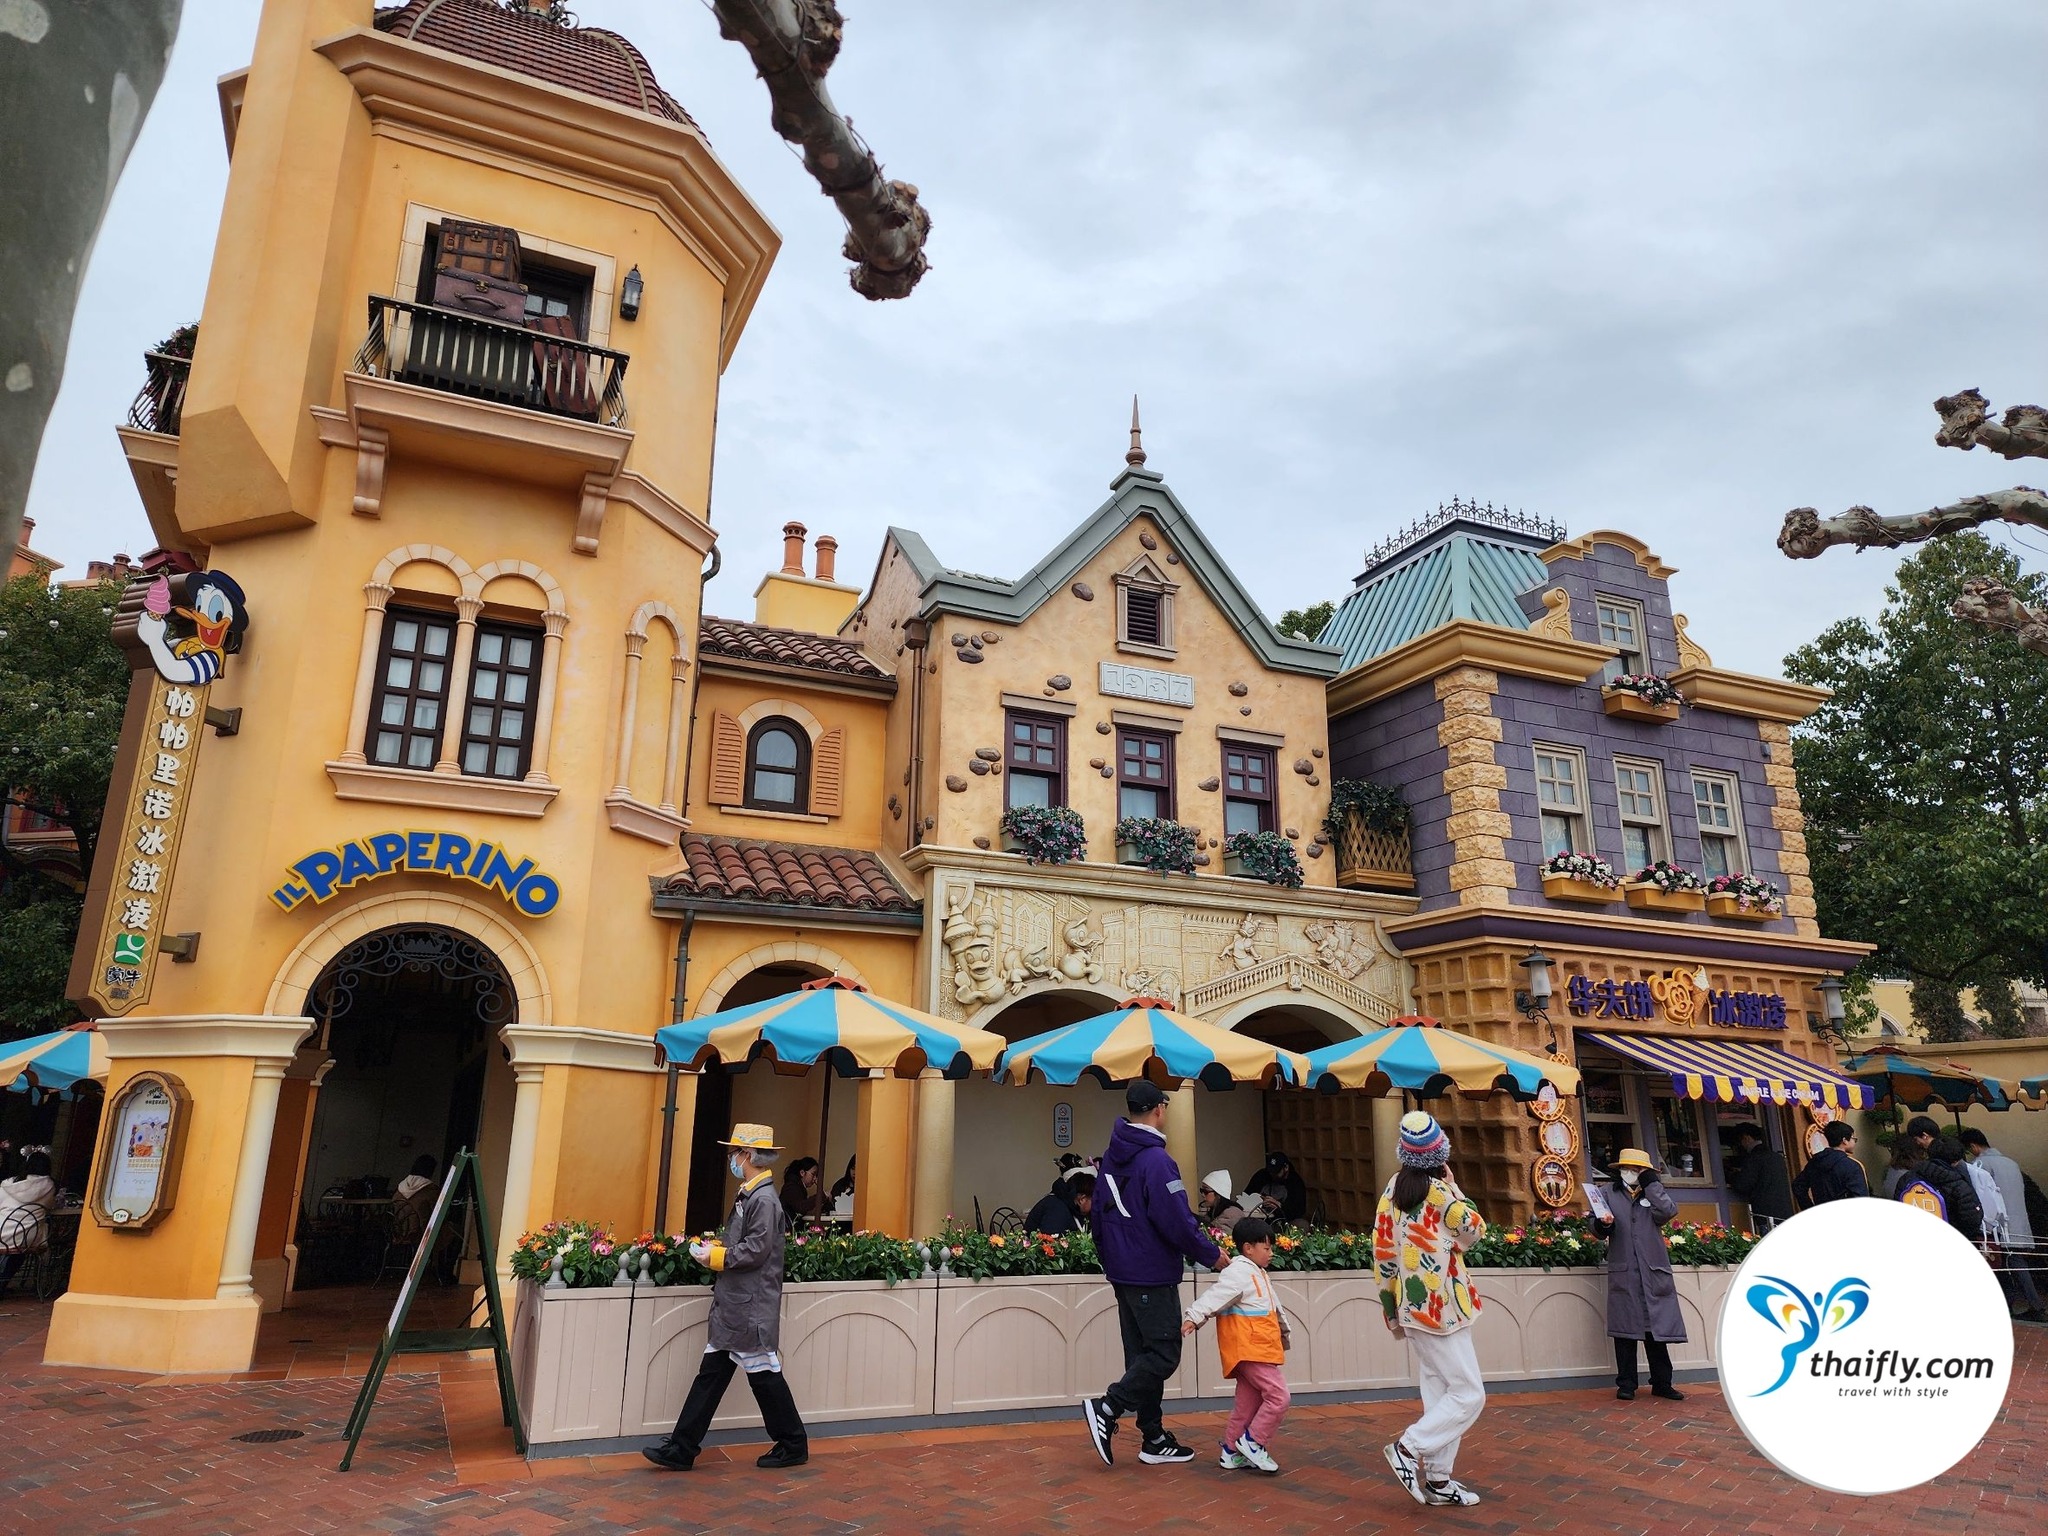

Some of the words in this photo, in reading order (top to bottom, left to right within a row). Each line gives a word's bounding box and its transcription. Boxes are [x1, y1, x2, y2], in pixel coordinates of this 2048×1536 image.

[120, 686, 196, 931] 帕帕里诺冰激凌
[274, 881, 308, 908] IL
[292, 831, 560, 915] PAPERINO
[107, 966, 142, 988] 蒙牛
[1564, 975, 1654, 1021] 华夫饼
[1708, 989, 1789, 1030] 冰激凌
